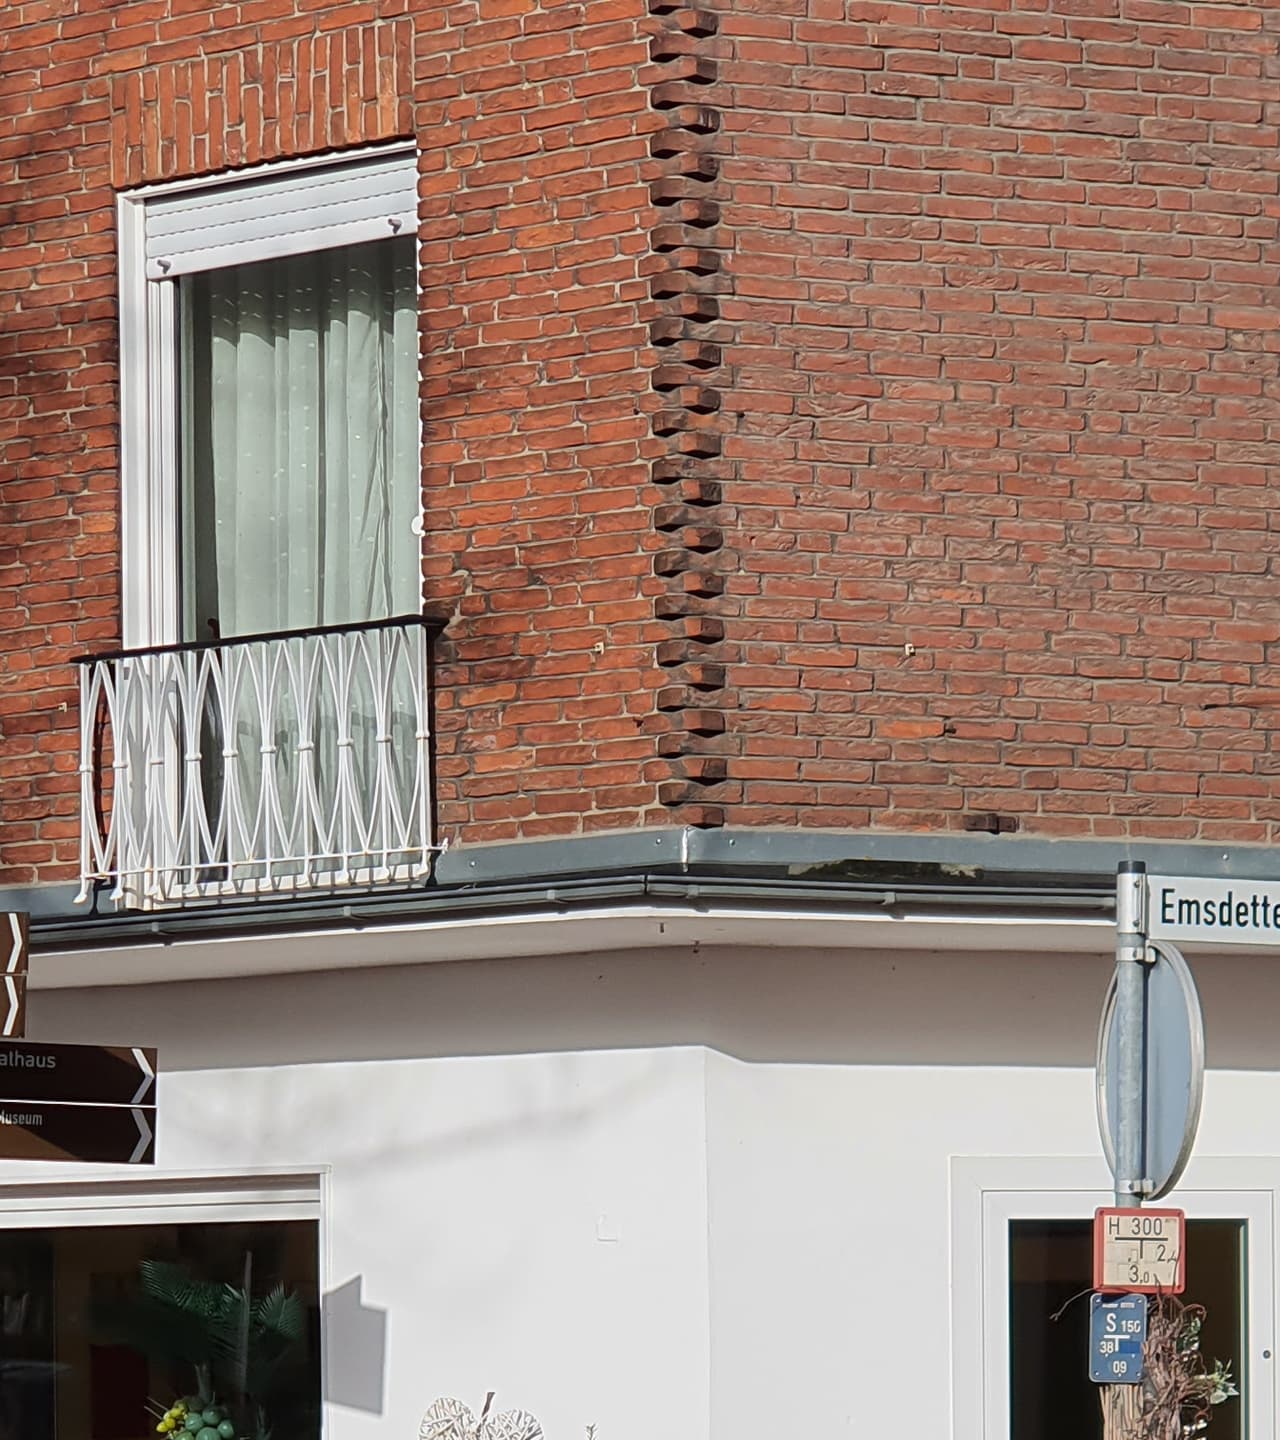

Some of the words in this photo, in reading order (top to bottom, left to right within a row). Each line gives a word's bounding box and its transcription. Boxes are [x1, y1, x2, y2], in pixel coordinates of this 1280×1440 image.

[1108, 1217, 1120, 1236] H
[1131, 1217, 1163, 1236] 300
[1128, 1264, 1150, 1284] 3,0
[1106, 1312, 1117, 1333] S
[1120, 1319, 1141, 1334] 150
